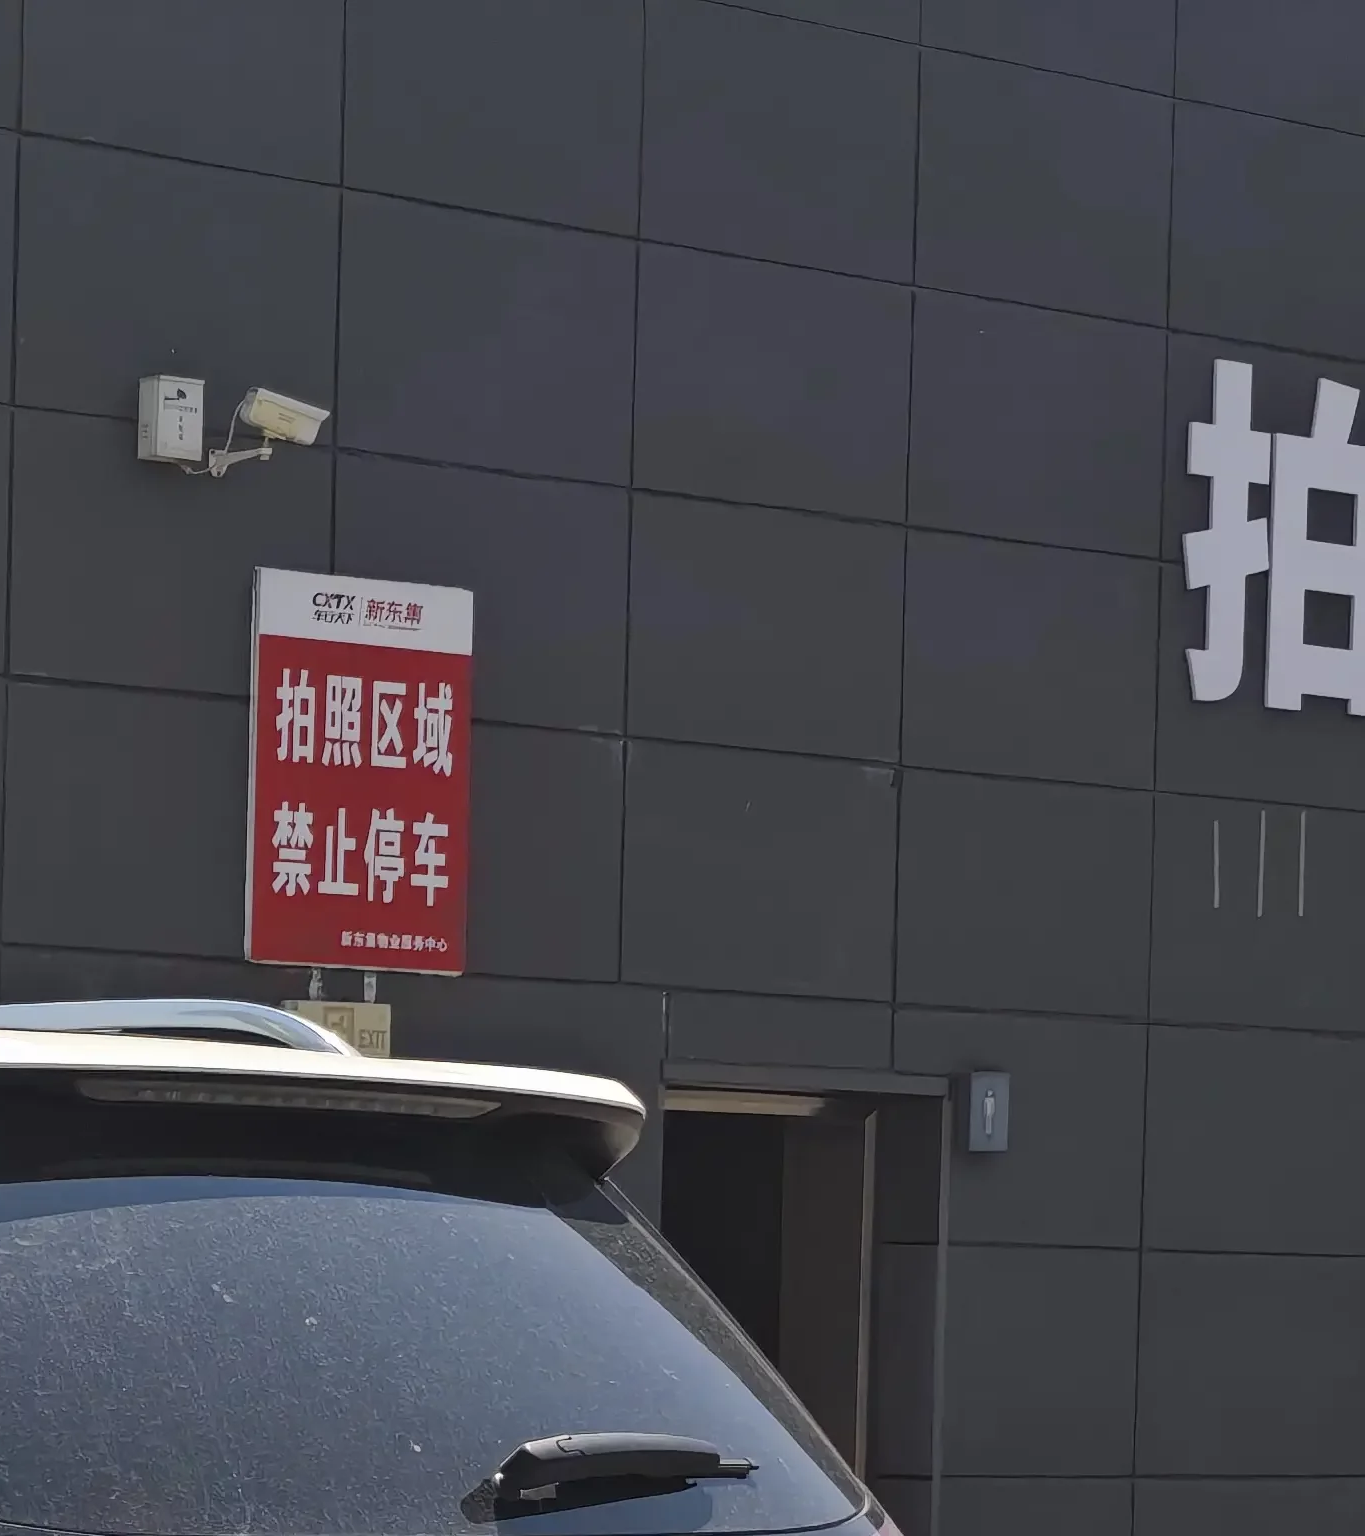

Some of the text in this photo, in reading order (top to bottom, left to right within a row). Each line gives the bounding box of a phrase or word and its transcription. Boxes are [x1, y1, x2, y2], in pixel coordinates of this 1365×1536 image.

[1182, 358, 1365, 717] 拍
[275, 668, 454, 777] 拍照区域
[271, 801, 450, 907] 禁止停车
